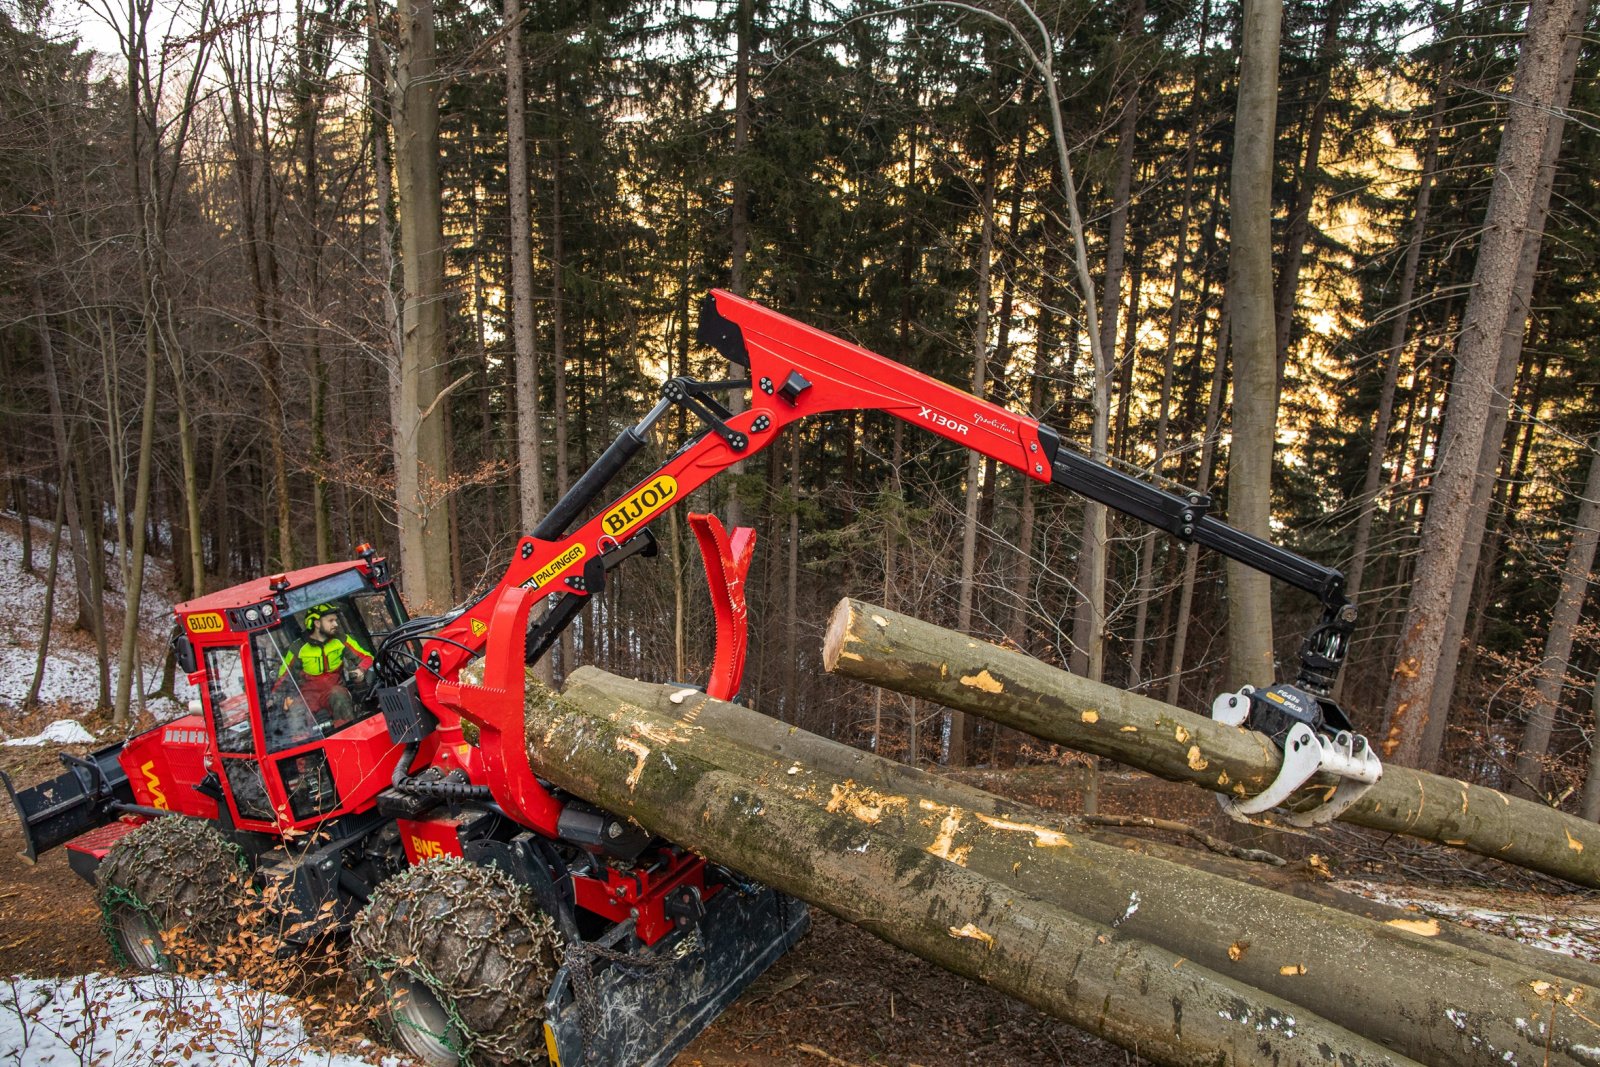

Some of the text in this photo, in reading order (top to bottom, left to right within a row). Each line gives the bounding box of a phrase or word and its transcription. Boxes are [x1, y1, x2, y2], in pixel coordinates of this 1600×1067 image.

[918, 406, 969, 436] X130R
[604, 481, 673, 534] BIJOL
[536, 546, 583, 584] PALFINGER
[189, 616, 222, 631] BIJOL
[411, 835, 444, 859] BWS
